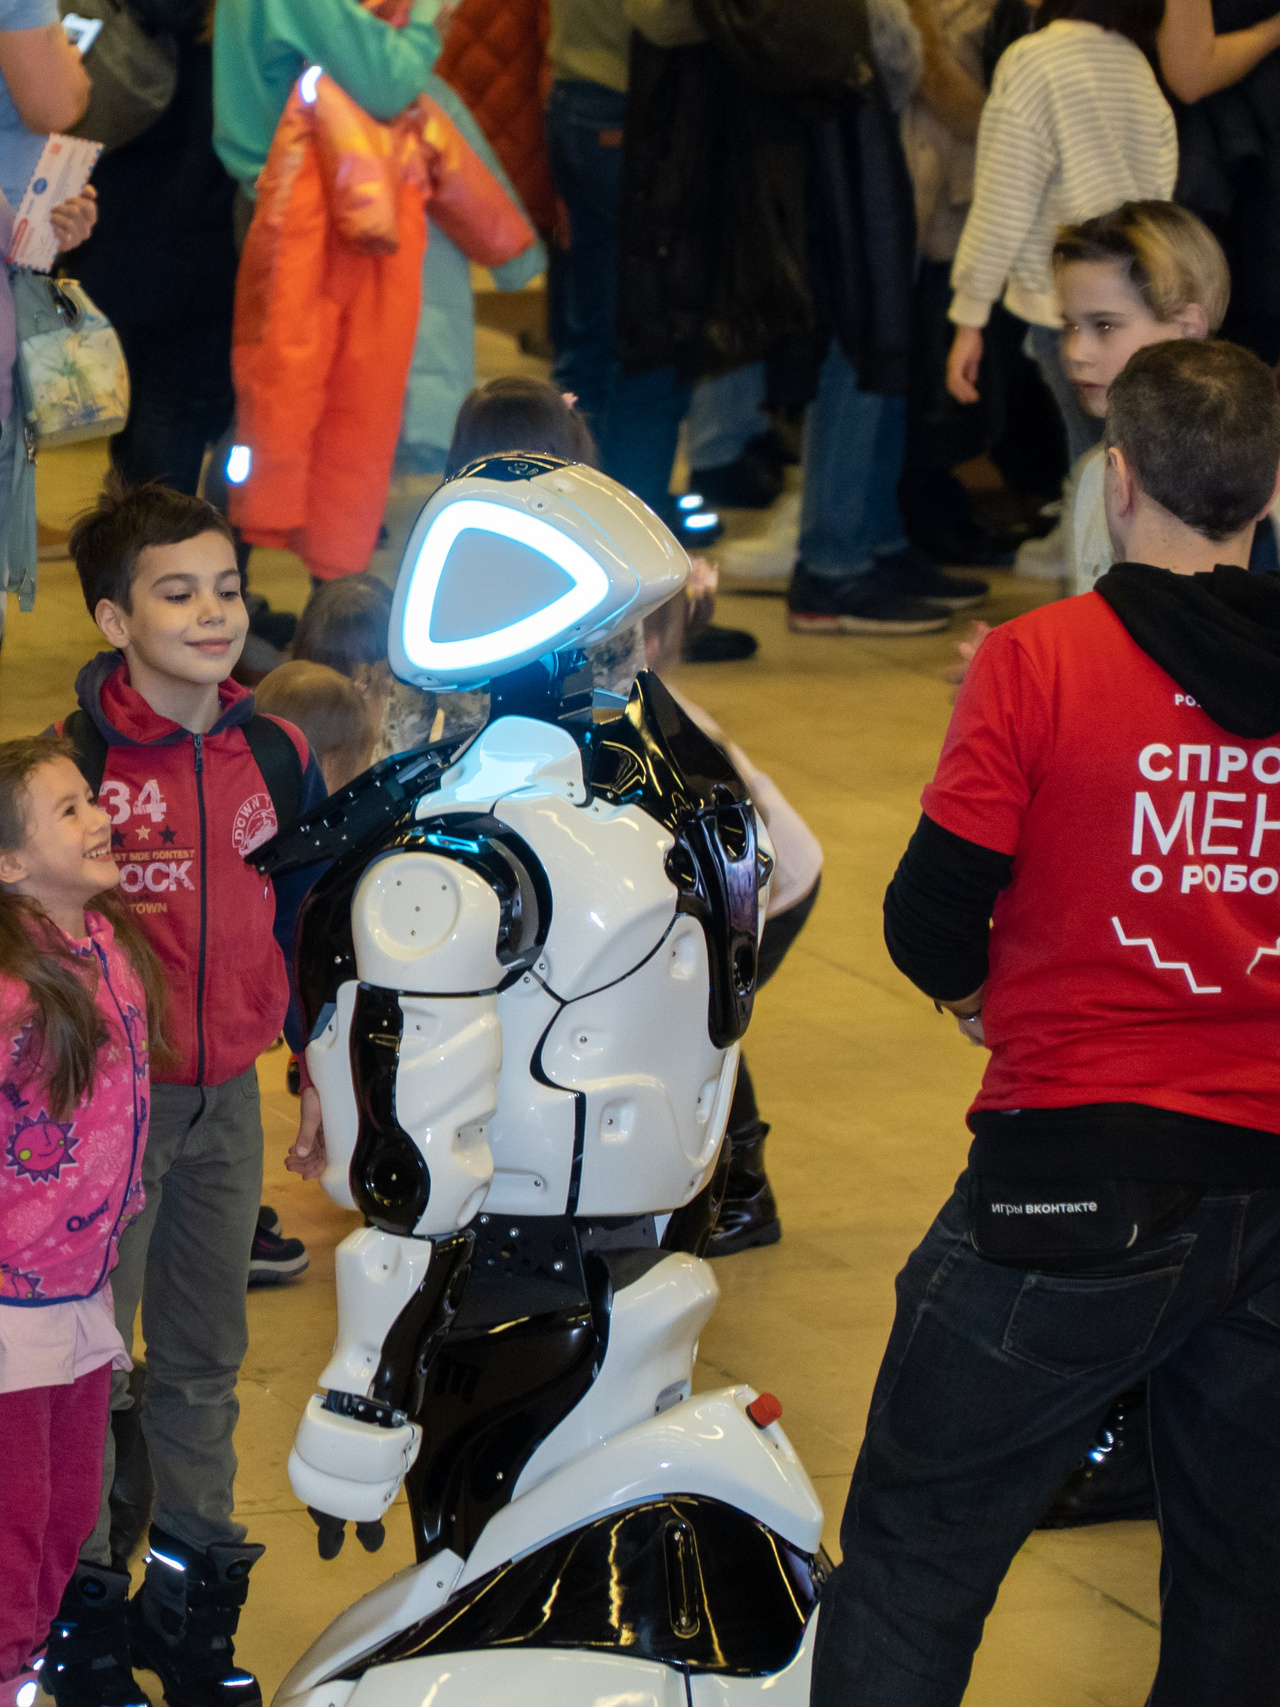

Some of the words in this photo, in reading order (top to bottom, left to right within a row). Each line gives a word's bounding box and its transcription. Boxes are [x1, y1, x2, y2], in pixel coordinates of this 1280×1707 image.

[1174, 693, 1201, 707] РО
[1138, 743, 1280, 784] СПРО
[98, 779, 166, 825] 34
[234, 797, 260, 840] DOWN
[113, 853, 127, 861] ST
[129, 852, 150, 861] SIDE
[152, 850, 195, 859] CONTEST
[119, 861, 195, 893] OCK
[1131, 864, 1163, 893] О
[1181, 864, 1280, 895] РОБО
[130, 902, 167, 915] TOWN
[991, 1203, 1023, 1216] игры
[1025, 1201, 1098, 1215] вконтакте
